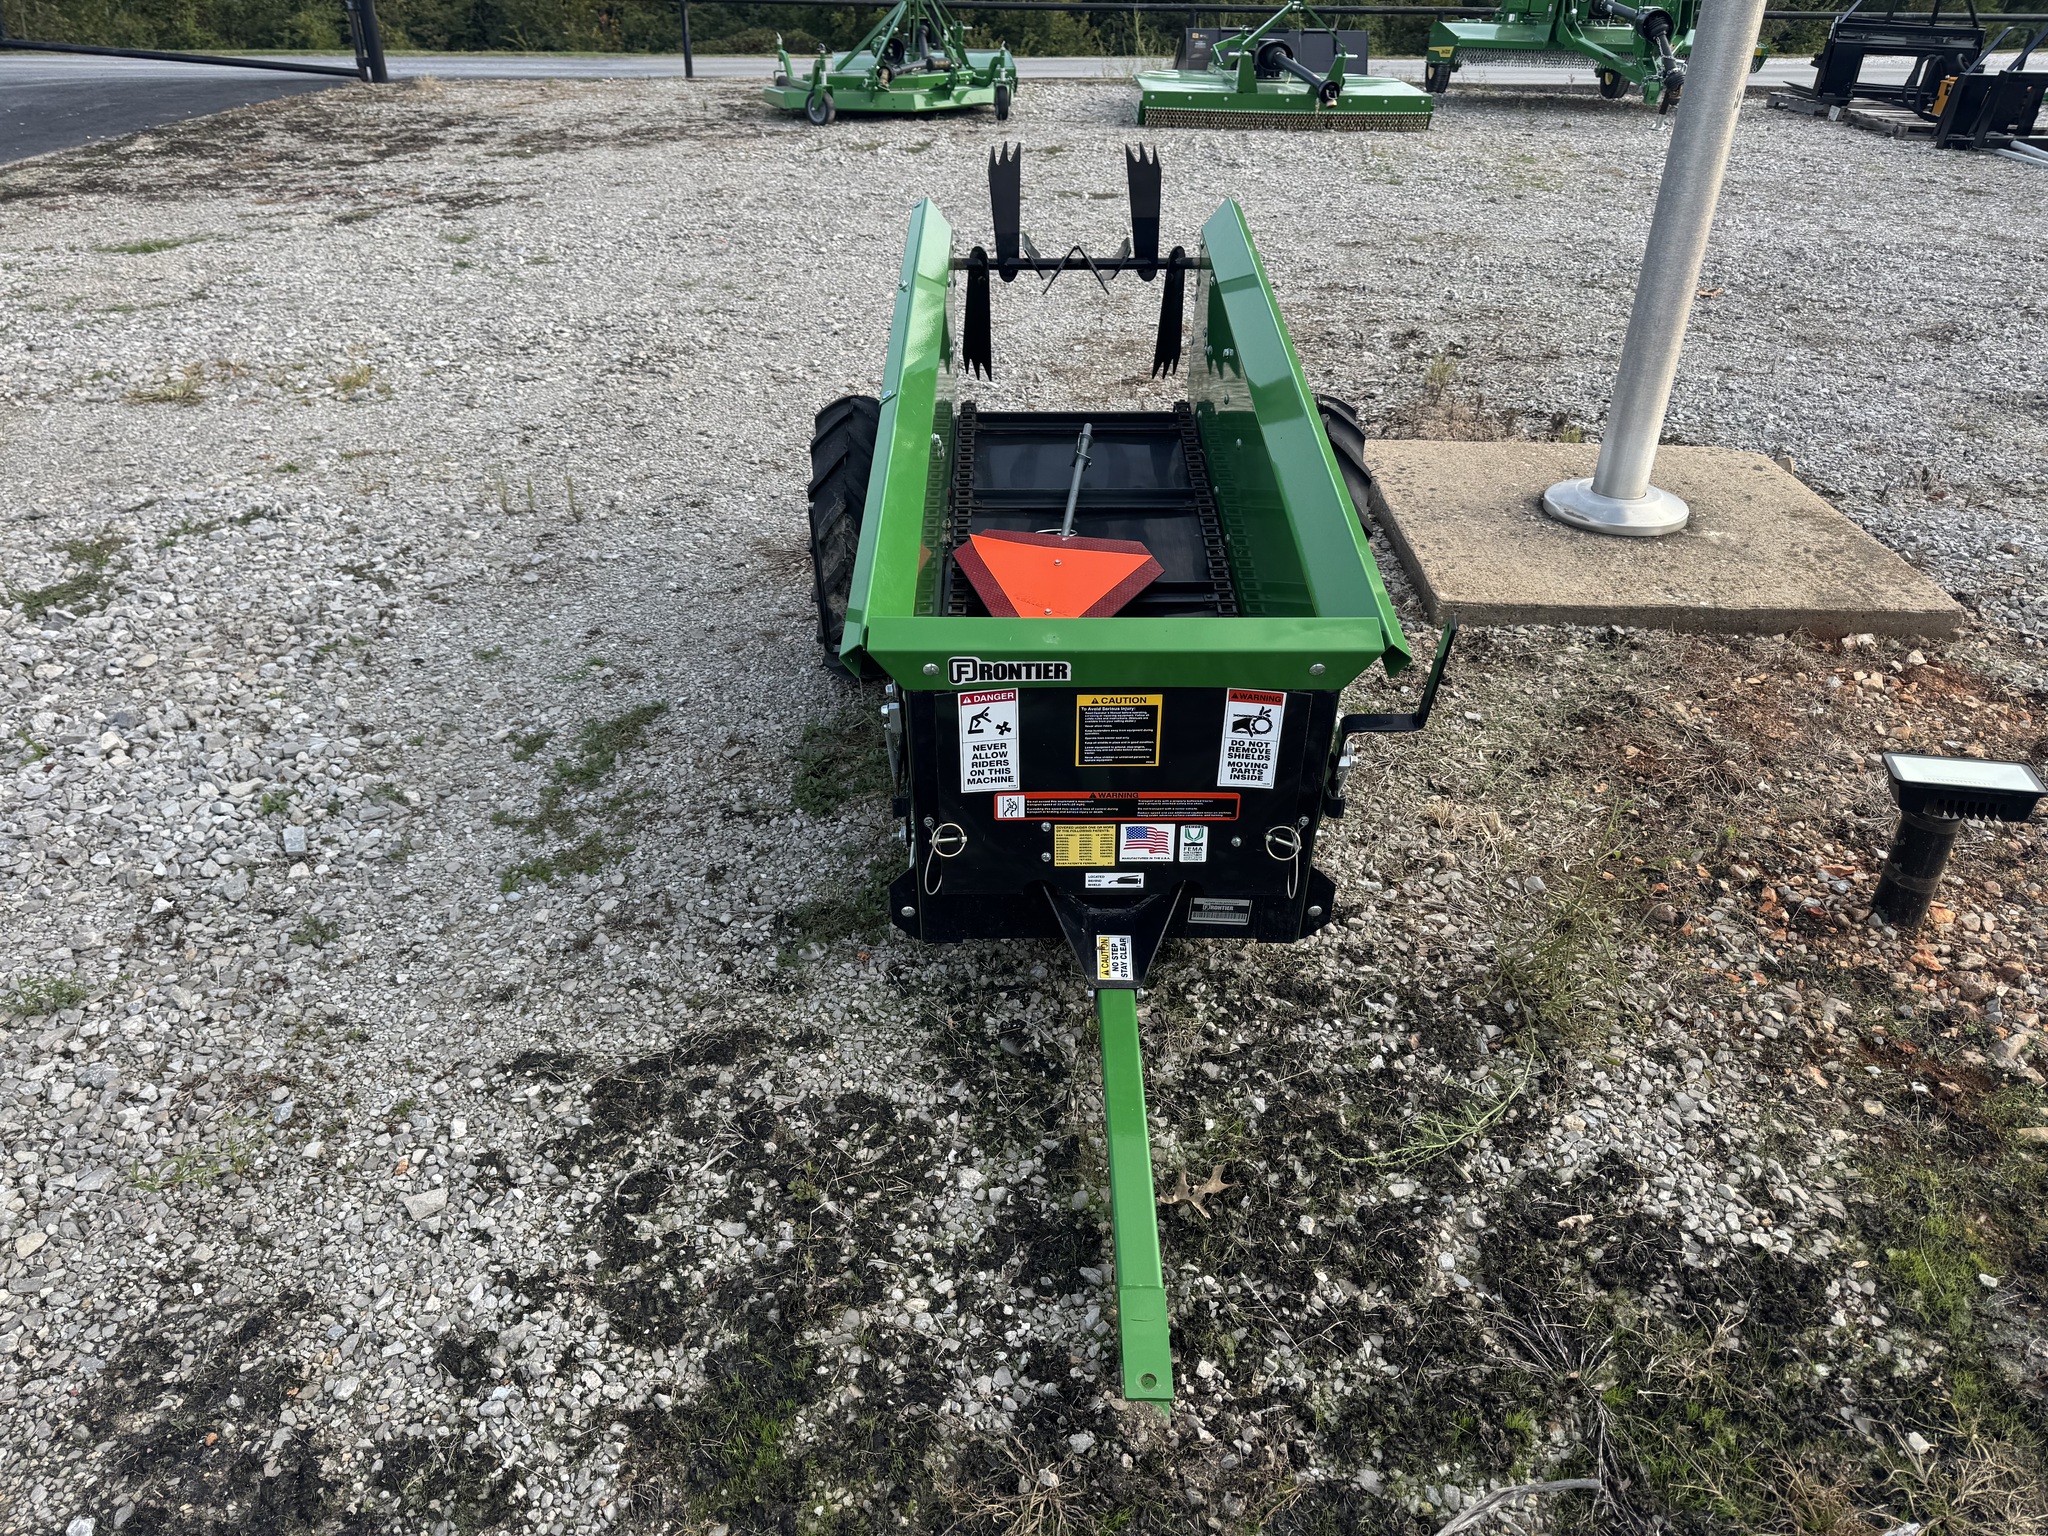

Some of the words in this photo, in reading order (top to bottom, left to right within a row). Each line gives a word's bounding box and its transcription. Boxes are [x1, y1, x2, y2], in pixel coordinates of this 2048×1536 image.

[949, 659, 1068, 684] FRONTIER
[973, 692, 1014, 703] DANGER
[1240, 693, 1281, 703] WARNING
[972, 743, 1007, 752] NEVER
[1228, 746, 1271, 755] REMOVE
[972, 751, 1008, 760] ALLOW
[1227, 753, 1270, 761] SHIELDS
[971, 759, 1009, 768] RIDERS
[1227, 761, 1268, 769] MOVING
[970, 769, 984, 777] ON
[988, 767, 1011, 776] THIS
[967, 775, 1014, 785] MACHINE
[1119, 937, 1127, 959] CLEAR
[1112, 962, 1119, 971] NO
[1120, 962, 1128, 977] STAY
